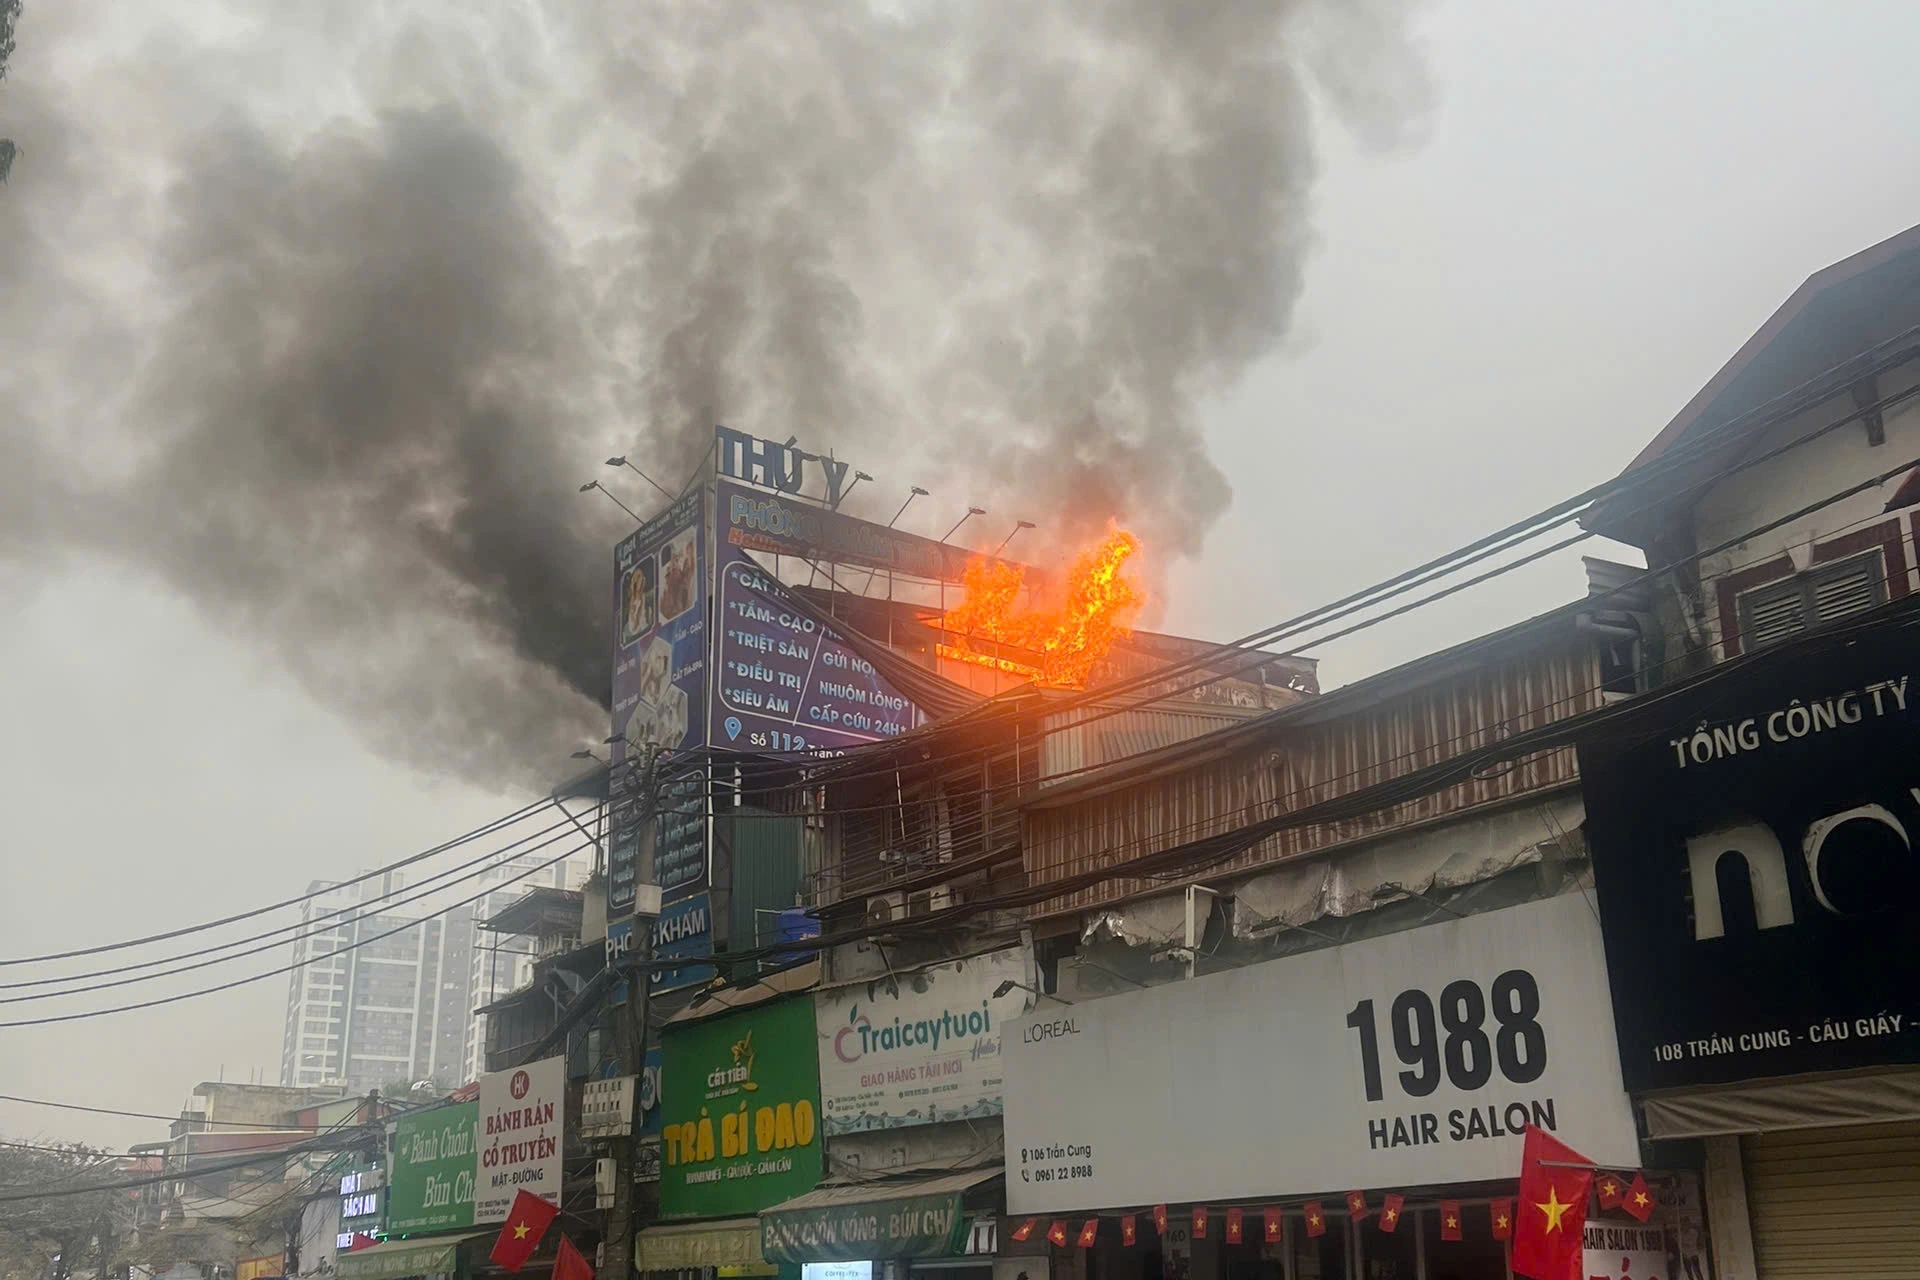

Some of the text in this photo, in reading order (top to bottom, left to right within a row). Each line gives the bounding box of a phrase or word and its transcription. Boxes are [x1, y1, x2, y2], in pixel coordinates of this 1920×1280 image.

[716, 425, 849, 511] THÚ Y
[779, 613, 815, 633] CẠO
[736, 631, 809, 660] TRIỆT SẢN
[823, 650, 848, 669] GỬI
[737, 660, 801, 693] ĐIỀU TRỊ
[732, 688, 789, 713] SIÊU ÂM
[820, 681, 903, 710] NHUỘM LÔNG
[810, 704, 839, 723] CẤP
[843, 708, 871, 729] CỨU
[1670, 675, 1909, 769] TỔNG CÔNG TY
[751, 733, 767, 747] Số
[771, 730, 805, 755] 112
[658, 906, 705, 945] KHÁM
[858, 1000, 991, 1054] Traicaytuoi
[1023, 1018, 1081, 1044] L'ORÉAL
[1346, 969, 1547, 1101] 1988
[1653, 1041, 1684, 1062] 108
[1687, 1032, 1735, 1059] TRẦN
[1740, 1027, 1791, 1053] CUNG
[1809, 1016, 1849, 1043] CẦU
[1855, 1009, 1902, 1038] GIẤY
[860, 1073, 885, 1088] GIAO
[887, 1066, 916, 1083] HÀNG
[486, 1098, 554, 1136] BÁNH RÁN
[663, 1099, 815, 1166] TRÀ BÍ ĐAO
[1368, 1098, 1557, 1150] HAIR SALON
[410, 1130, 438, 1164] Bánh
[440, 1117, 469, 1158] Cuốn
[483, 1139, 499, 1168] CỔ
[501, 1127, 556, 1162] TRUYỀN
[1030, 1143, 1091, 1161] 106 Trần Cung
[423, 1172, 450, 1208] Bún
[1035, 1168, 1055, 1182] 0961
[1057, 1167, 1069, 1180] 22
[841, 1210, 878, 1243] NÓNG
[889, 1206, 920, 1239] BÚN
[1583, 1227, 1606, 1250] HAIR
[1607, 1229, 1639, 1252] SALON
